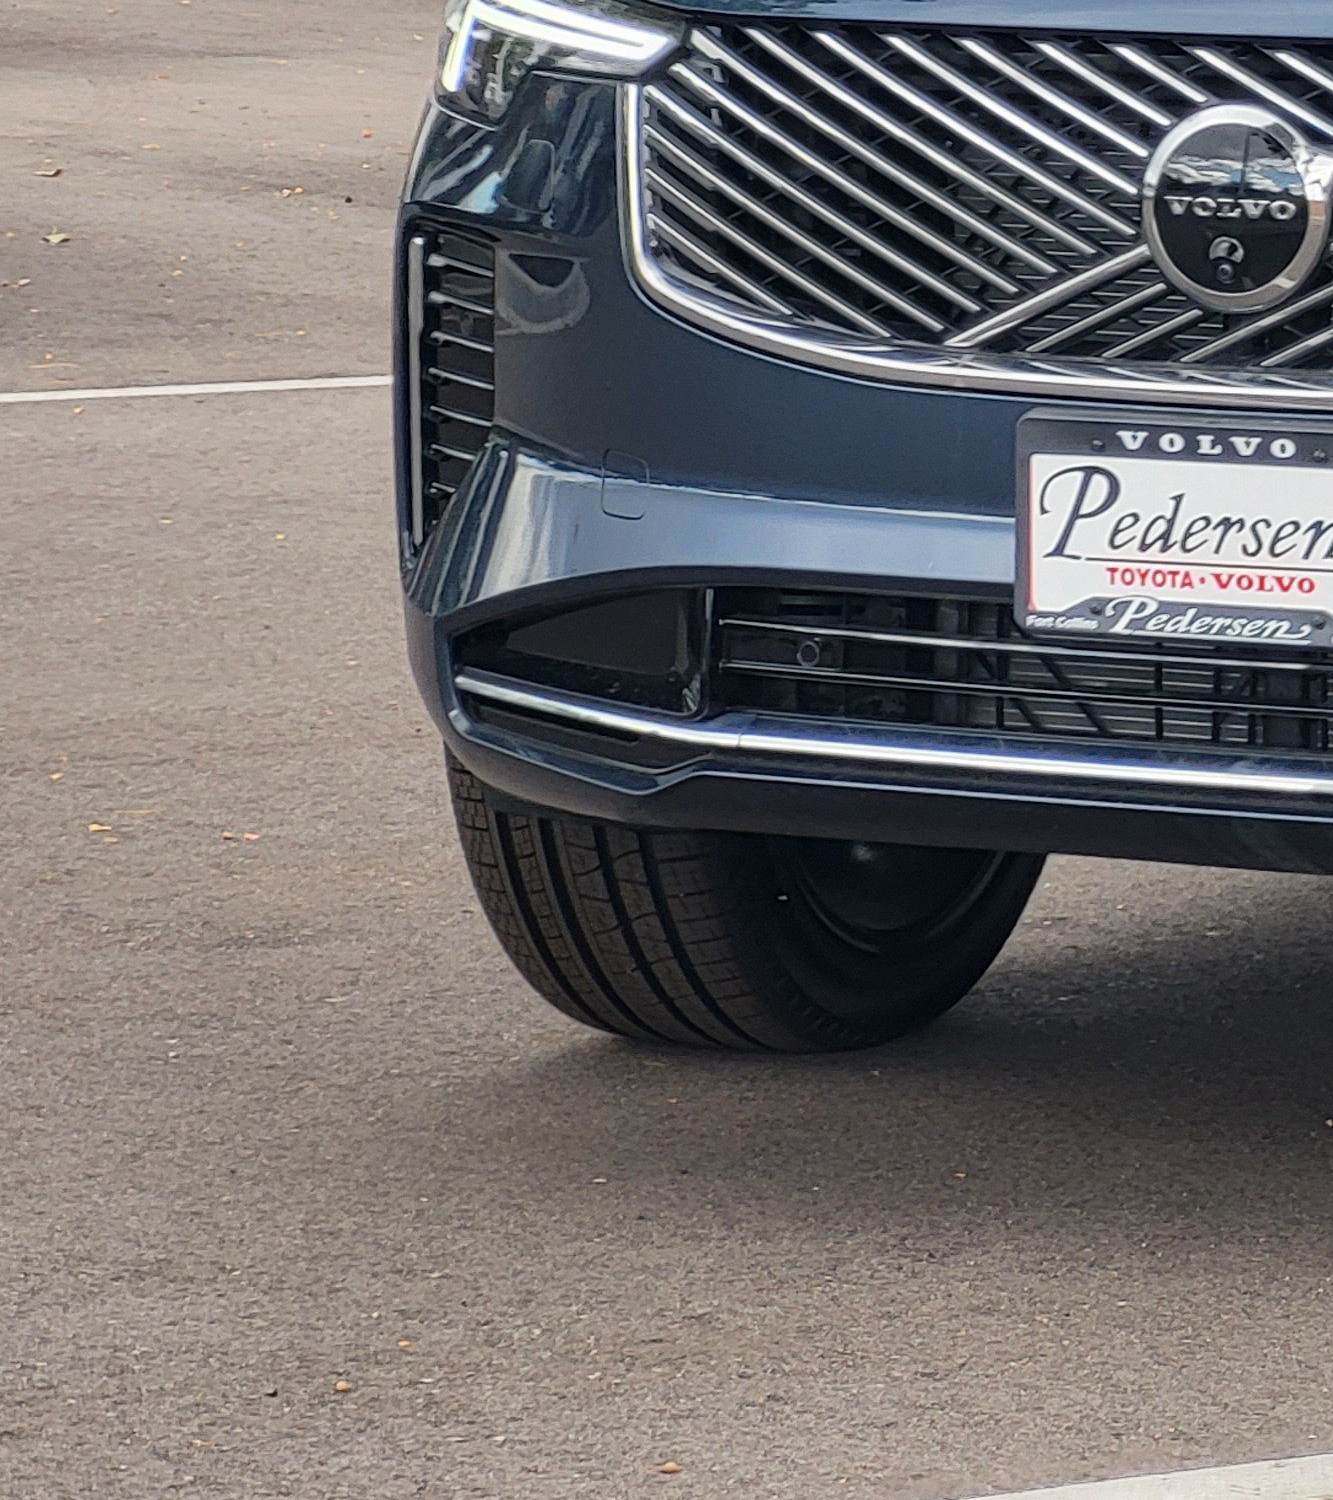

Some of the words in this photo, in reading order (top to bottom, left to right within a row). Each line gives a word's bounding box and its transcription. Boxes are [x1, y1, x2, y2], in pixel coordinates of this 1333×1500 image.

[1163, 196, 1297, 221] VOLVO
[1115, 430, 1297, 459] VOLVO
[1106, 567, 1195, 590] TOYOTA
[1210, 573, 1316, 594] VOLVO
[1104, 595, 1312, 640] Pedersen
